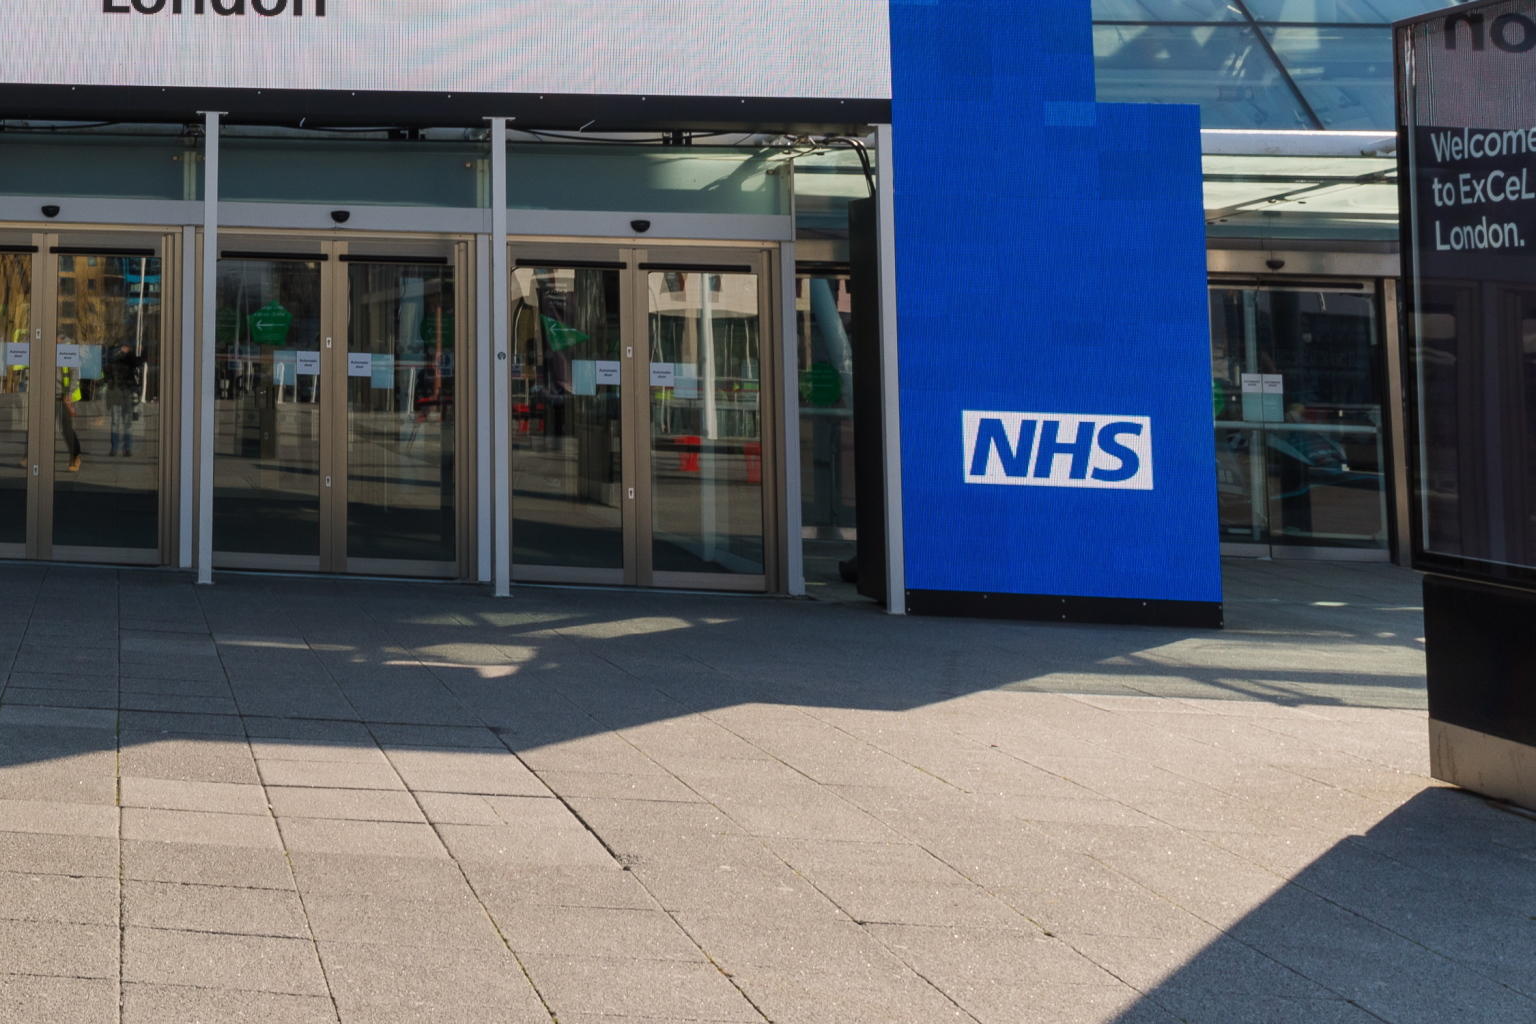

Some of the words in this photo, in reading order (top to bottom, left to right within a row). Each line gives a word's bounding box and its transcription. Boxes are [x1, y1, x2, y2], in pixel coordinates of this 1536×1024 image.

[1432, 177, 1456, 207] to
[1459, 167, 1536, 205] ExCeL
[1434, 215, 1526, 252] London.
[969, 418, 1143, 482] NHS
